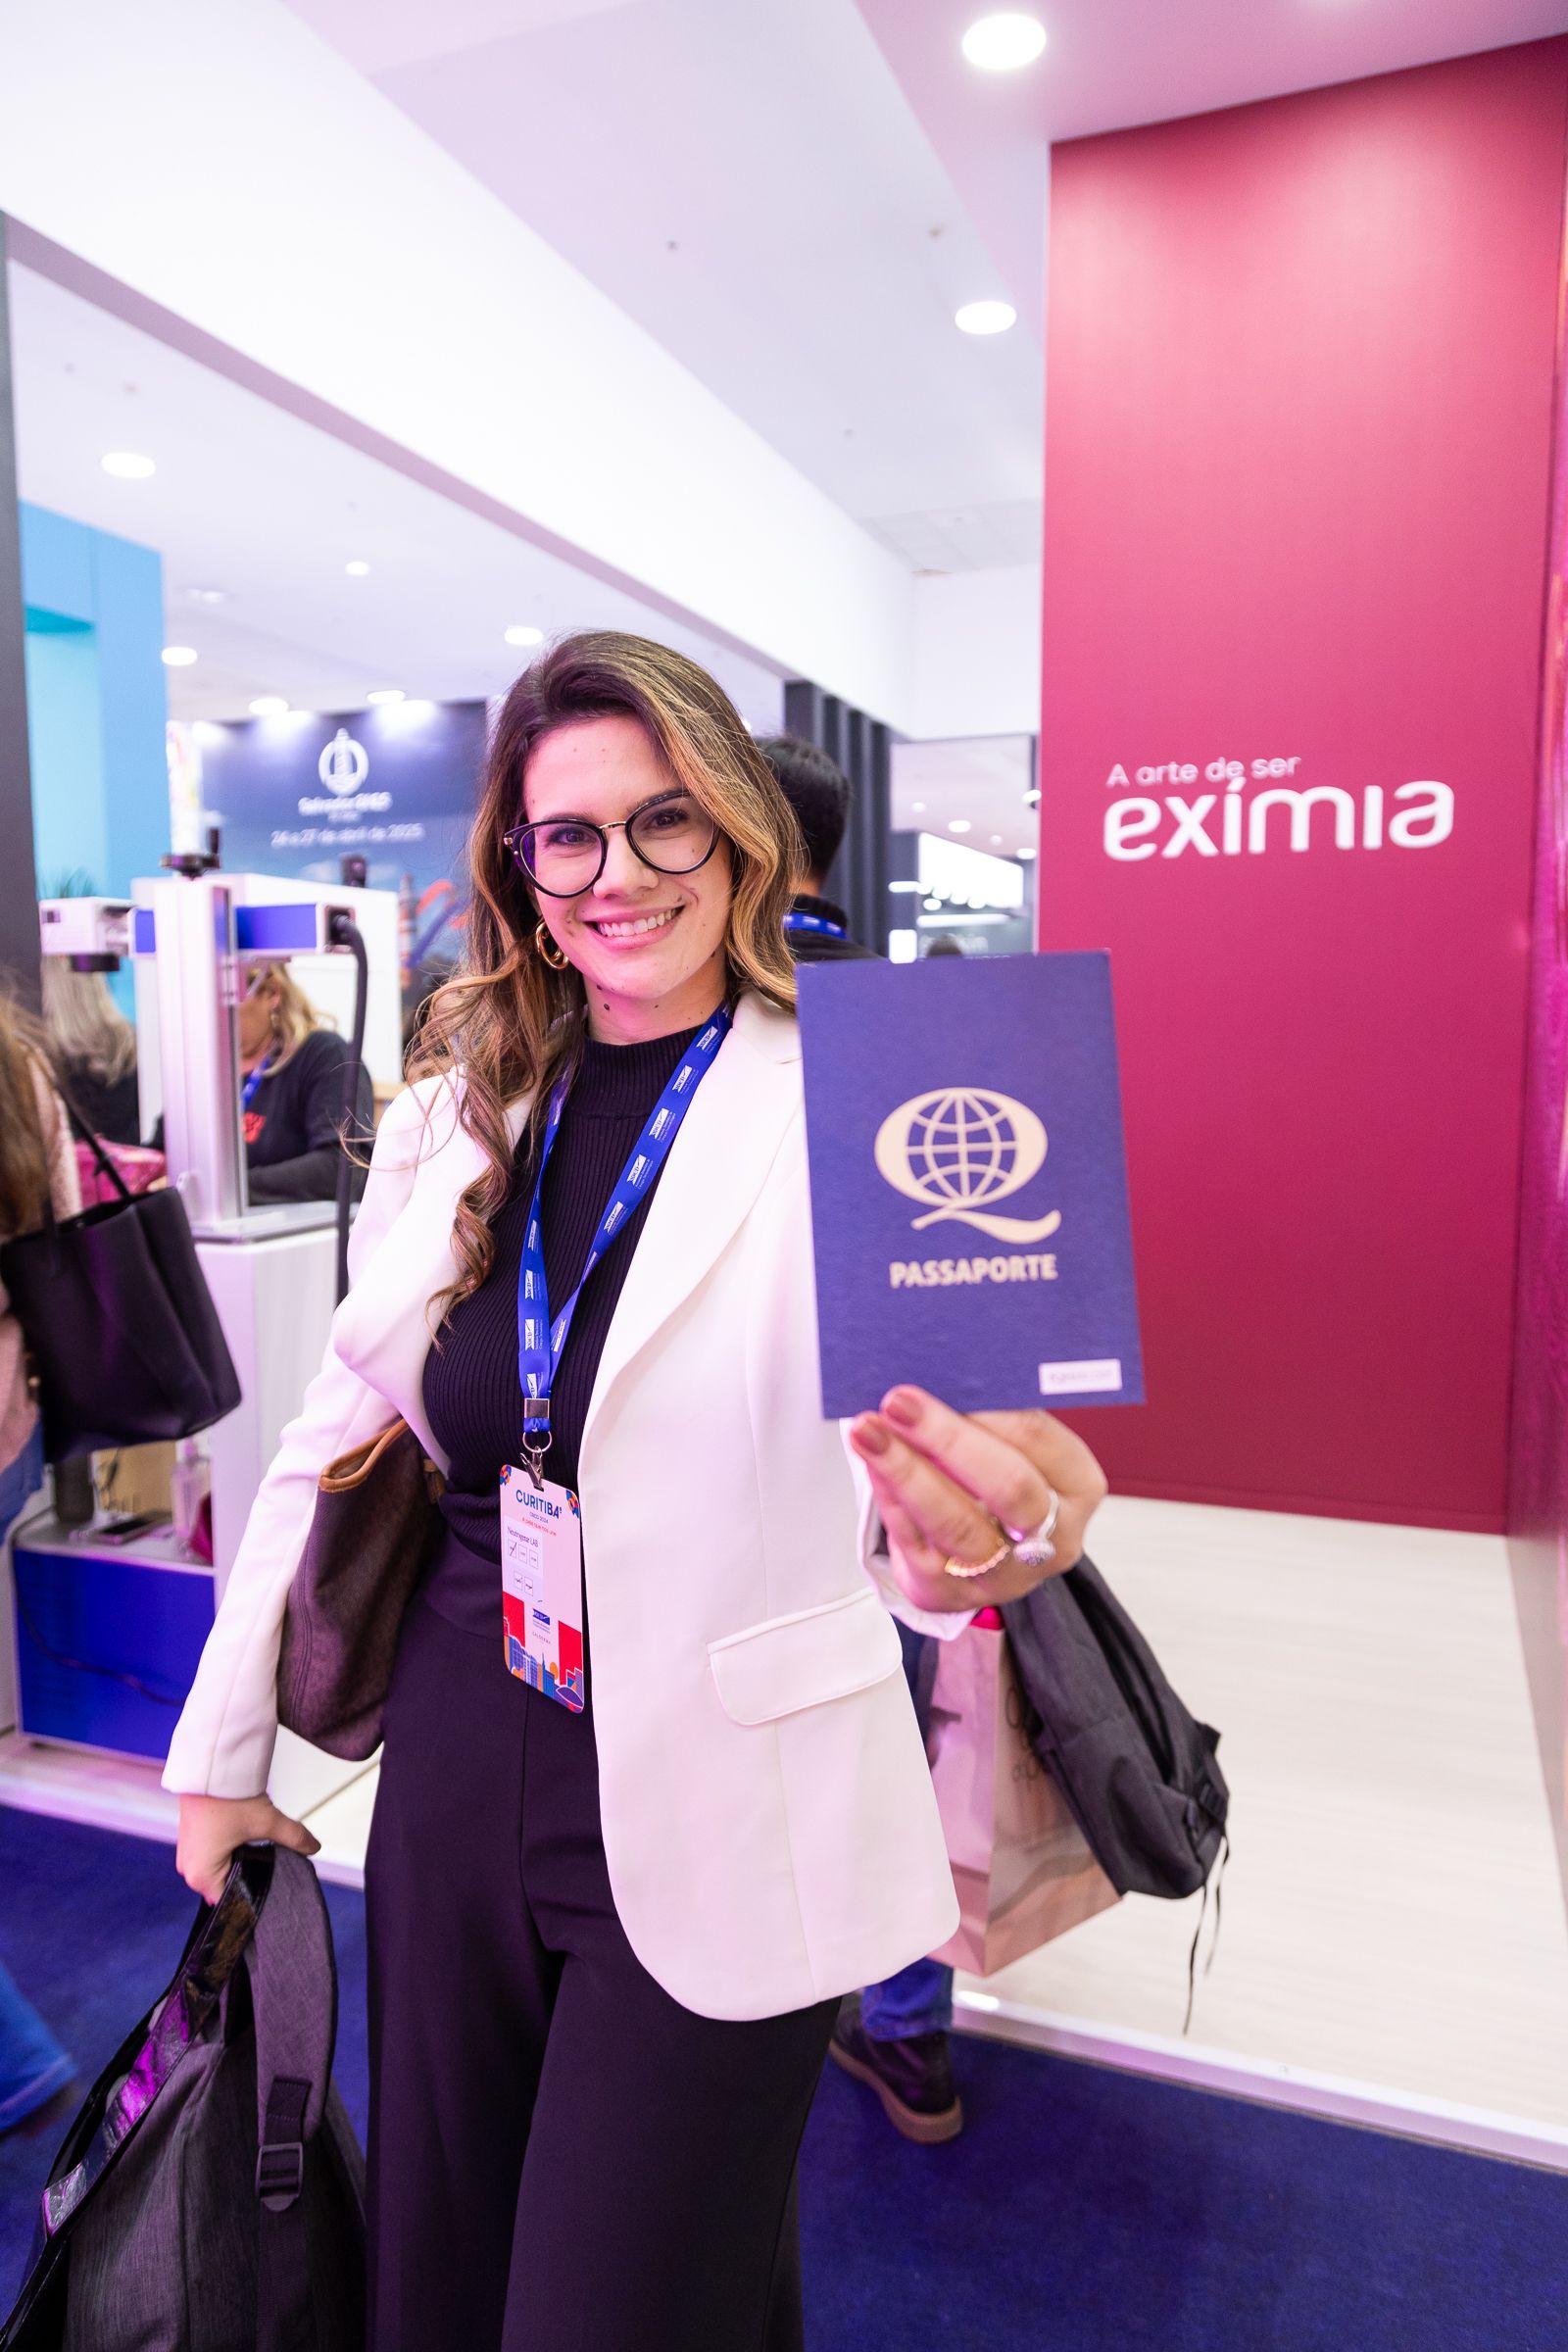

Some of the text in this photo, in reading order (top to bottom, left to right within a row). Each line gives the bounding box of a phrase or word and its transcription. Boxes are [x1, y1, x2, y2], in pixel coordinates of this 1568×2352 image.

[1105, 756, 1301, 789] A arte de ser
[890, 1253, 1058, 1289] PASSAPORTE
